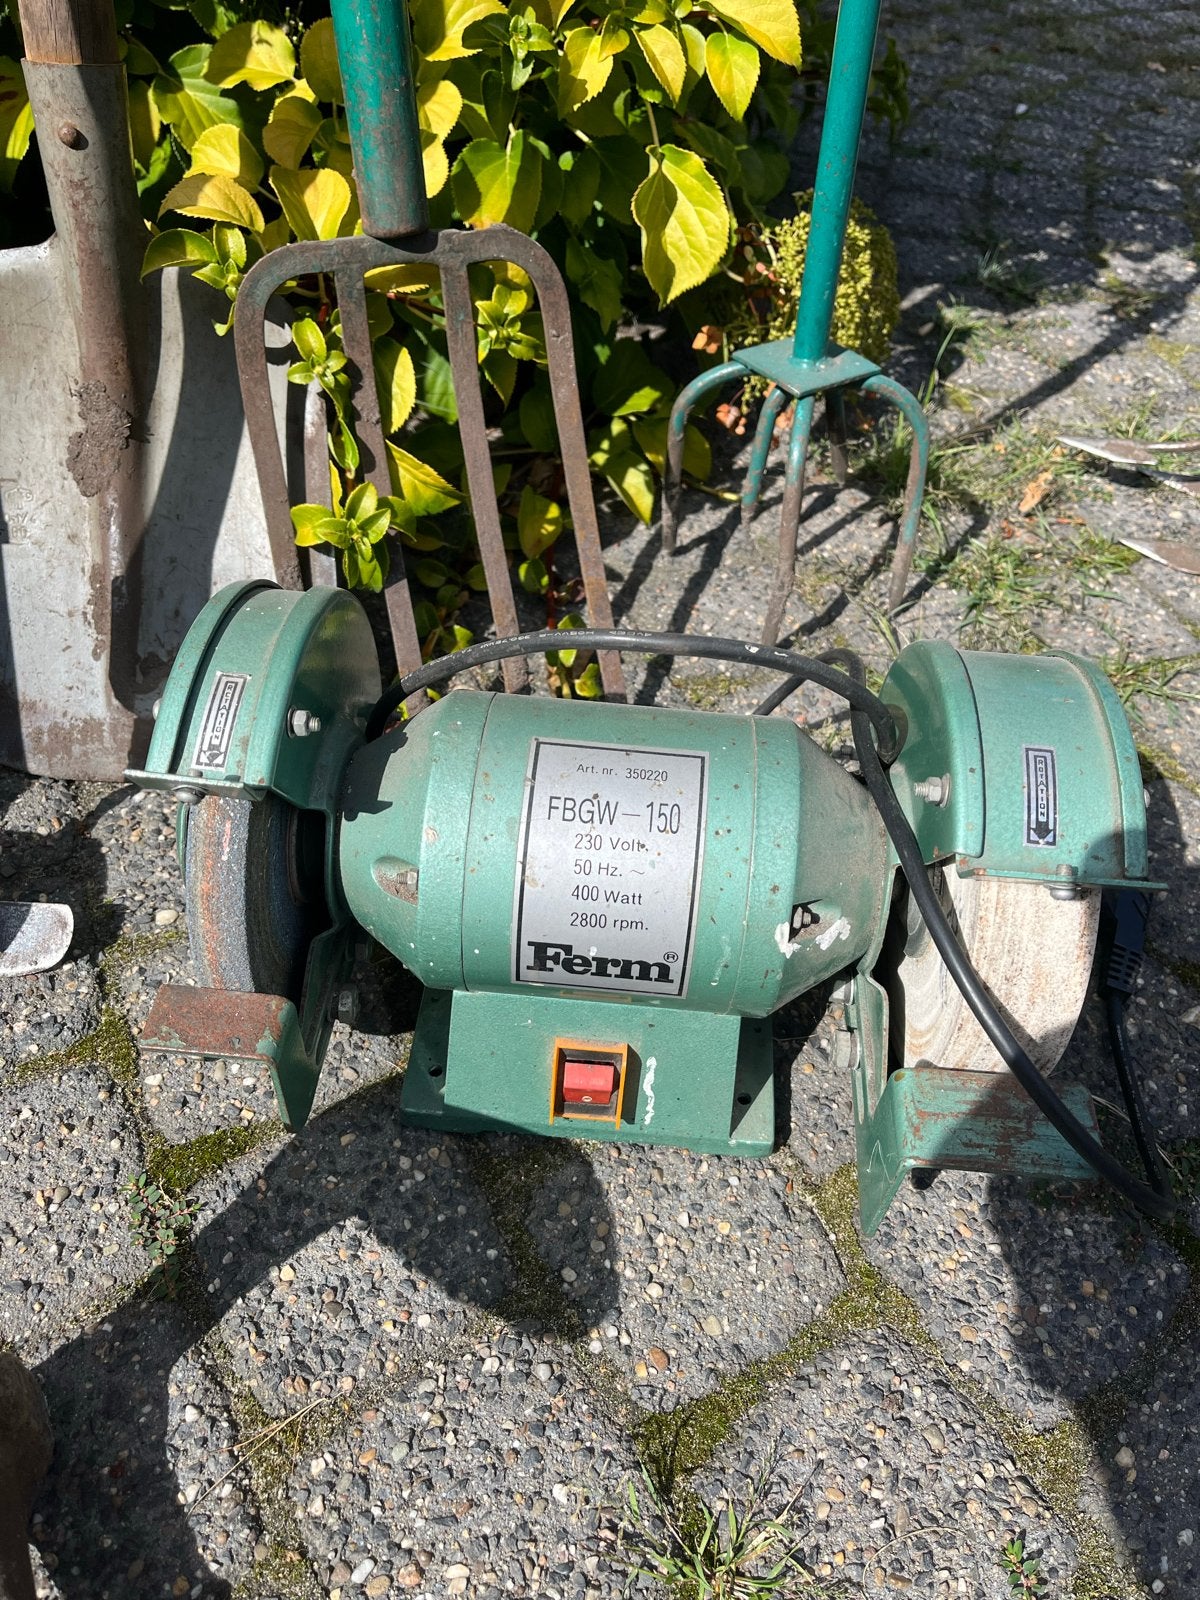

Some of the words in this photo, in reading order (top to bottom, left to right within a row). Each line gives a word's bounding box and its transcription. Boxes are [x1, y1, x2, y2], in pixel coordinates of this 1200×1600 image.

[576, 763, 598, 774] Art.
[602, 766, 618, 776] nr.
[625, 767, 668, 782] 350220
[1037, 759, 1047, 818] ROTATION
[574, 833, 602, 851] 230
[573, 859, 592, 876] 50
[597, 862, 623, 877] Hz.
[571, 884, 599, 902] 400
[604, 889, 643, 906] Watt
[569, 911, 607, 929] 2800
[613, 916, 649, 931] rpm.
